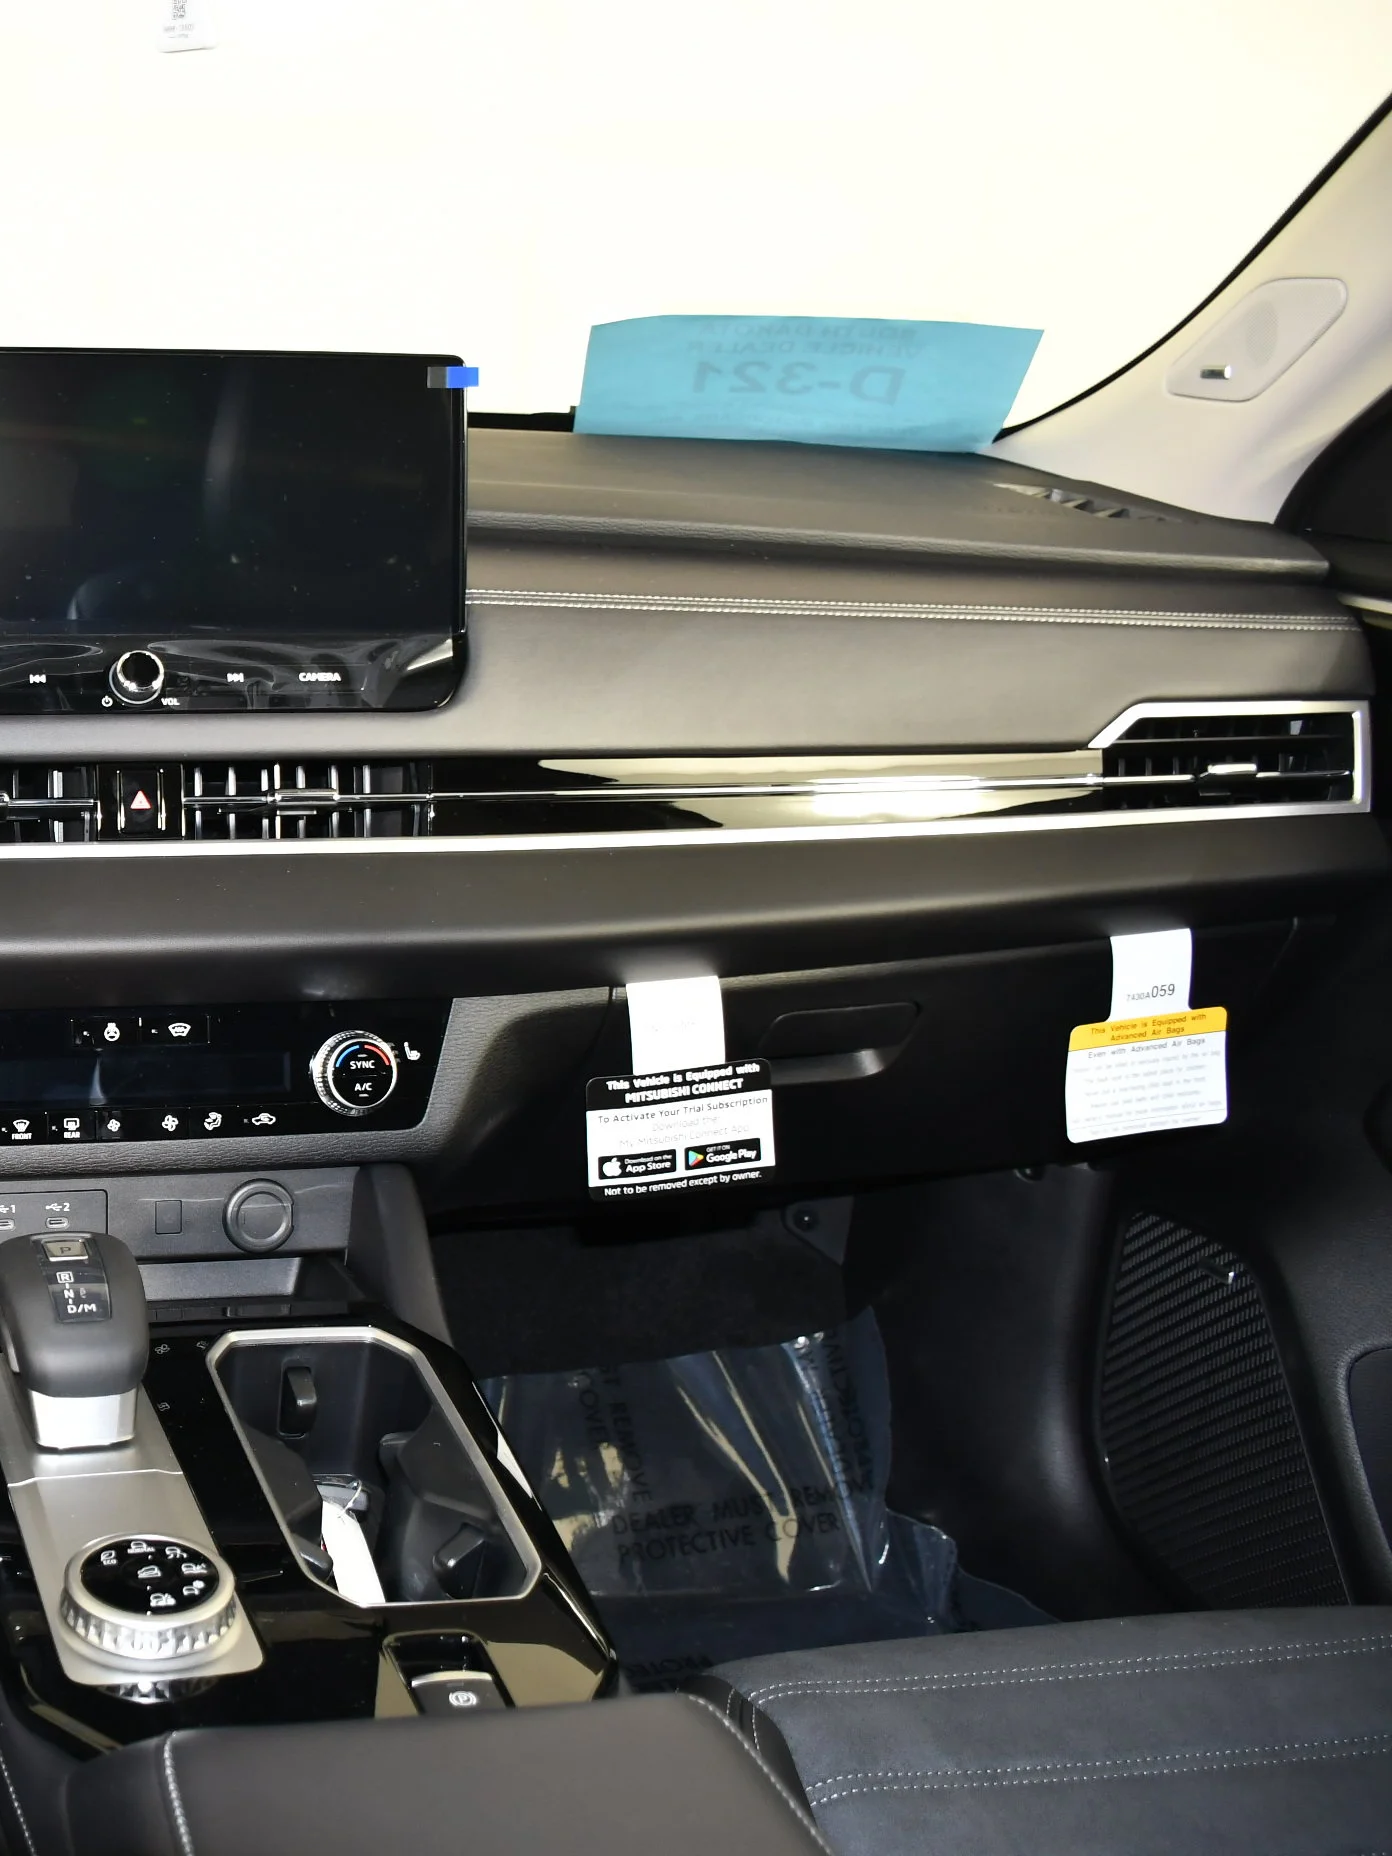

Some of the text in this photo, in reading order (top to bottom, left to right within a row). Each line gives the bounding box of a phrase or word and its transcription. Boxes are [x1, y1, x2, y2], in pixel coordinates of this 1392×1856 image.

[298, 672, 342, 682] CAMERA
[161, 697, 180, 706] VOL
[1091, 1027, 1106, 1035] This
[1110, 1022, 1138, 1032] Vehicle
[1151, 1016, 1187, 1027] Equipped
[1191, 1013, 1207, 1021] with
[1110, 1031, 1147, 1041] Advanced
[1166, 1026, 1185, 1035] Bags
[1088, 1051, 1106, 1059] Even
[1111, 1047, 1126, 1055] with
[1131, 1043, 1168, 1053] Advanced
[1187, 1038, 1205, 1046] Bags
[350, 1059, 375, 1069] SYNC
[606, 1063, 760, 1091] This Vehicle is Equipped with
[354, 1082, 372, 1091] A/C
[625, 1078, 744, 1104] MITSUBISHI CONNECT
[598, 1096, 768, 1124] To Activate Your Trial Subscription
[11, 1132, 32, 1140] FRONT
[63, 1131, 80, 1139] REAR
[706, 1148, 757, 1165] Google Play
[625, 1160, 671, 1173] App Store
[604, 1170, 762, 1196] Not to be removed except by owner.
[63, 1202, 70, 1212] 2
[63, 1288, 75, 1299] N
[66, 1303, 97, 1314] D/M
[611, 1503, 696, 1535] DEALER
[617, 1512, 841, 1566] PROTECTIVE COVER
